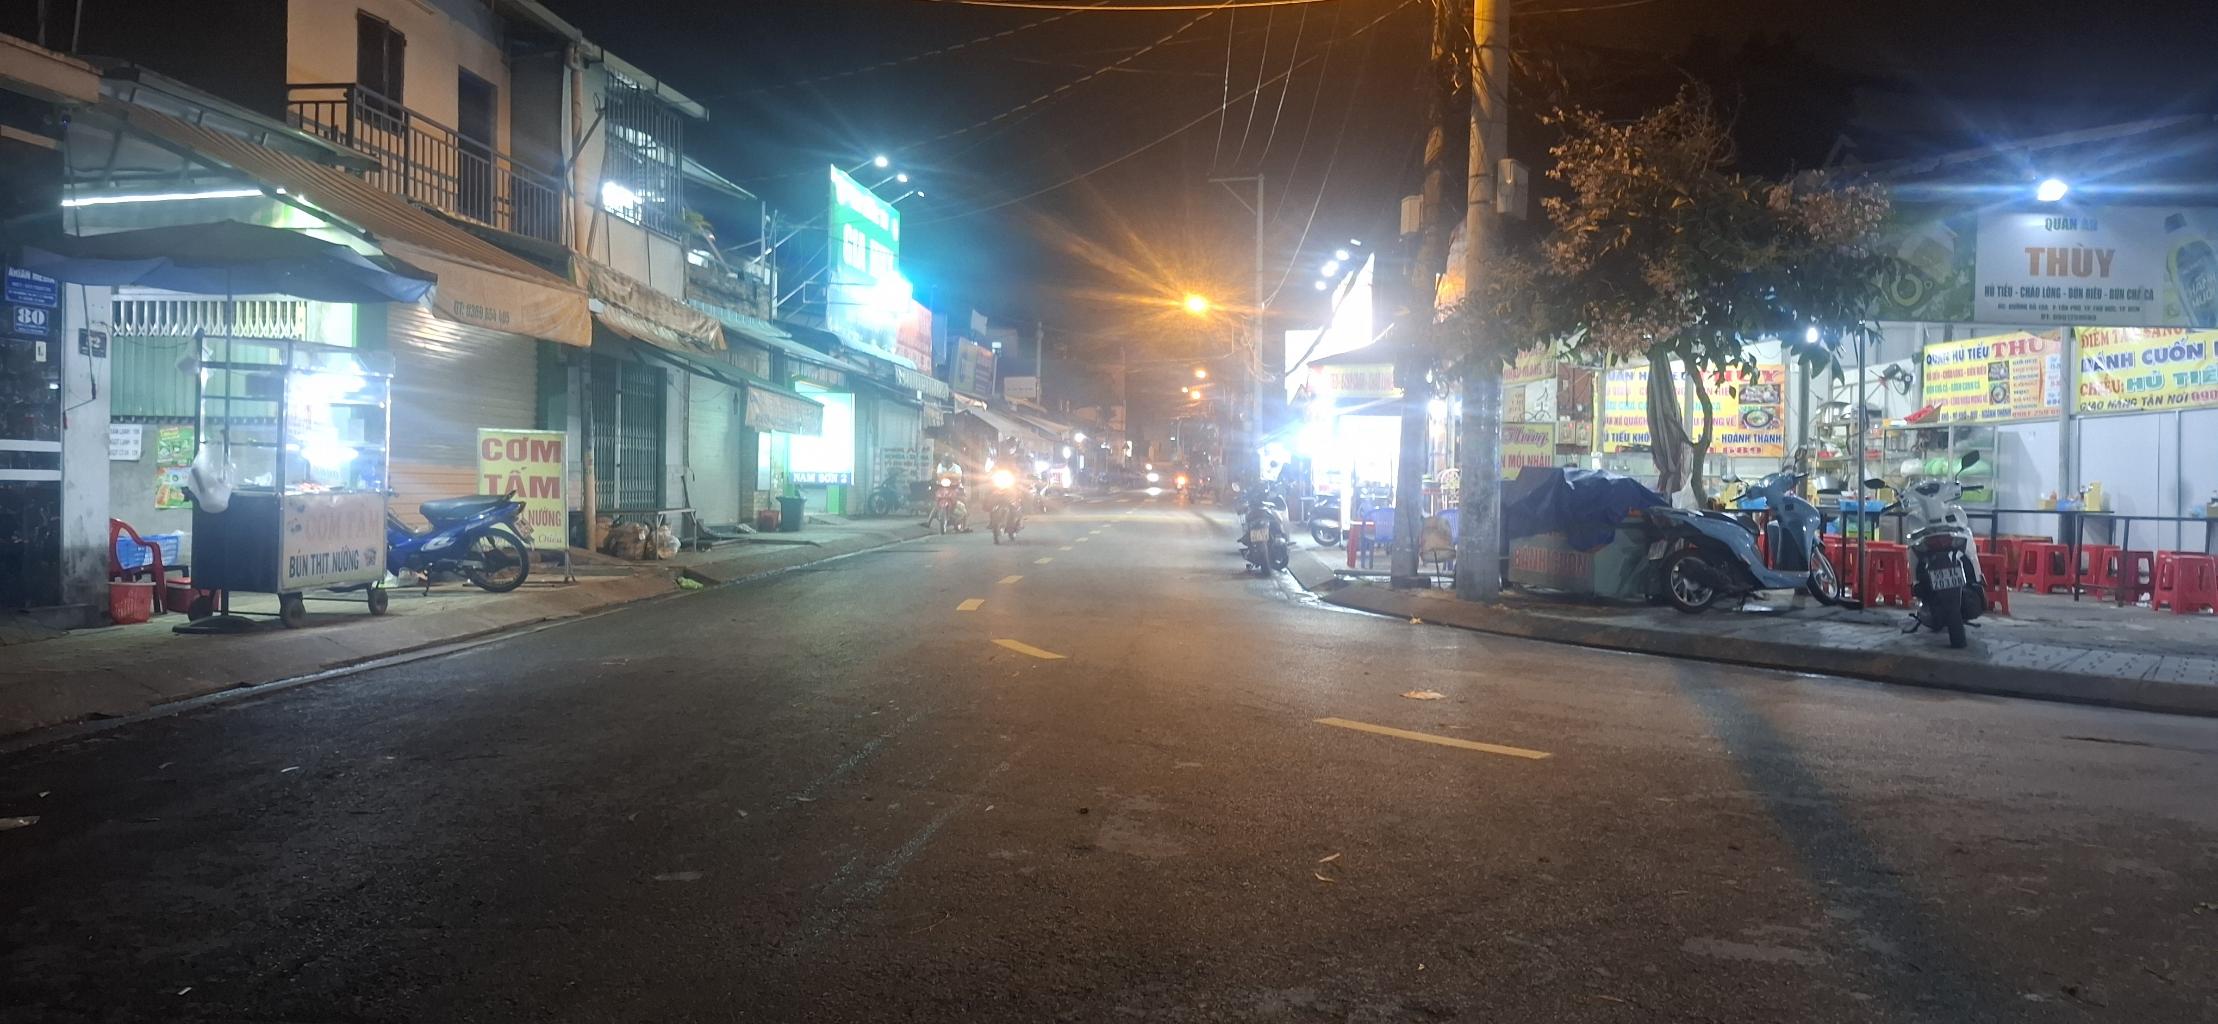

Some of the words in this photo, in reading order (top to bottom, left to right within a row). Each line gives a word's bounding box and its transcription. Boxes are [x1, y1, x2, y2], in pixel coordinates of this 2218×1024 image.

[2024, 243, 2116, 278] THÙY
[18, 308, 45, 325] 80
[1967, 342, 1989, 360] TIẾU
[2141, 336, 2205, 366] CUỐN
[481, 437, 561, 463] CƠM
[484, 466, 561, 499] TẤM
[289, 548, 309, 578] BÚN
[311, 553, 330, 580] THỊT
[332, 545, 360, 573] NƯỚNG
